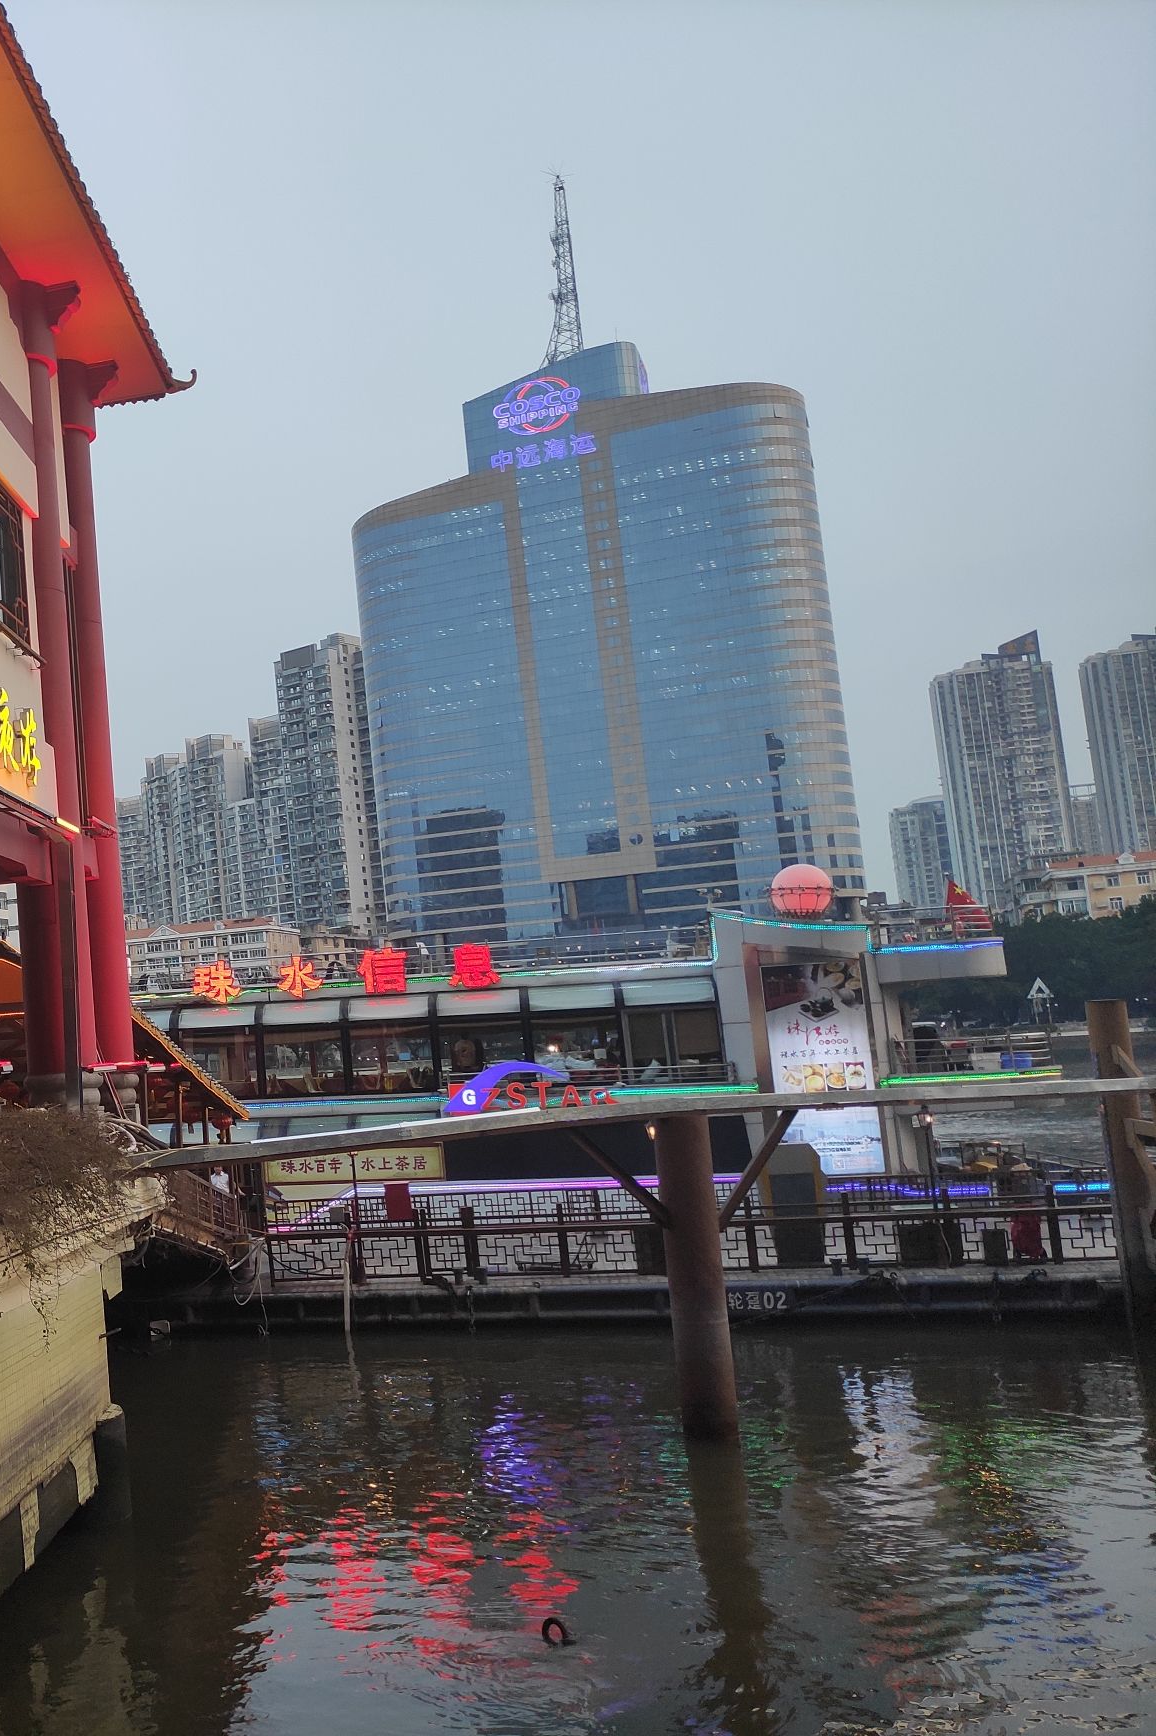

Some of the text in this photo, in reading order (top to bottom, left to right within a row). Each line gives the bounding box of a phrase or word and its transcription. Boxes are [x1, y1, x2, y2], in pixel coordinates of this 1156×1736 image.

[493, 387, 581, 418] COSCO
[497, 402, 578, 429] SHIPPING
[491, 433, 596, 473] 中远海运
[194, 943, 500, 1004] 珠水信息
